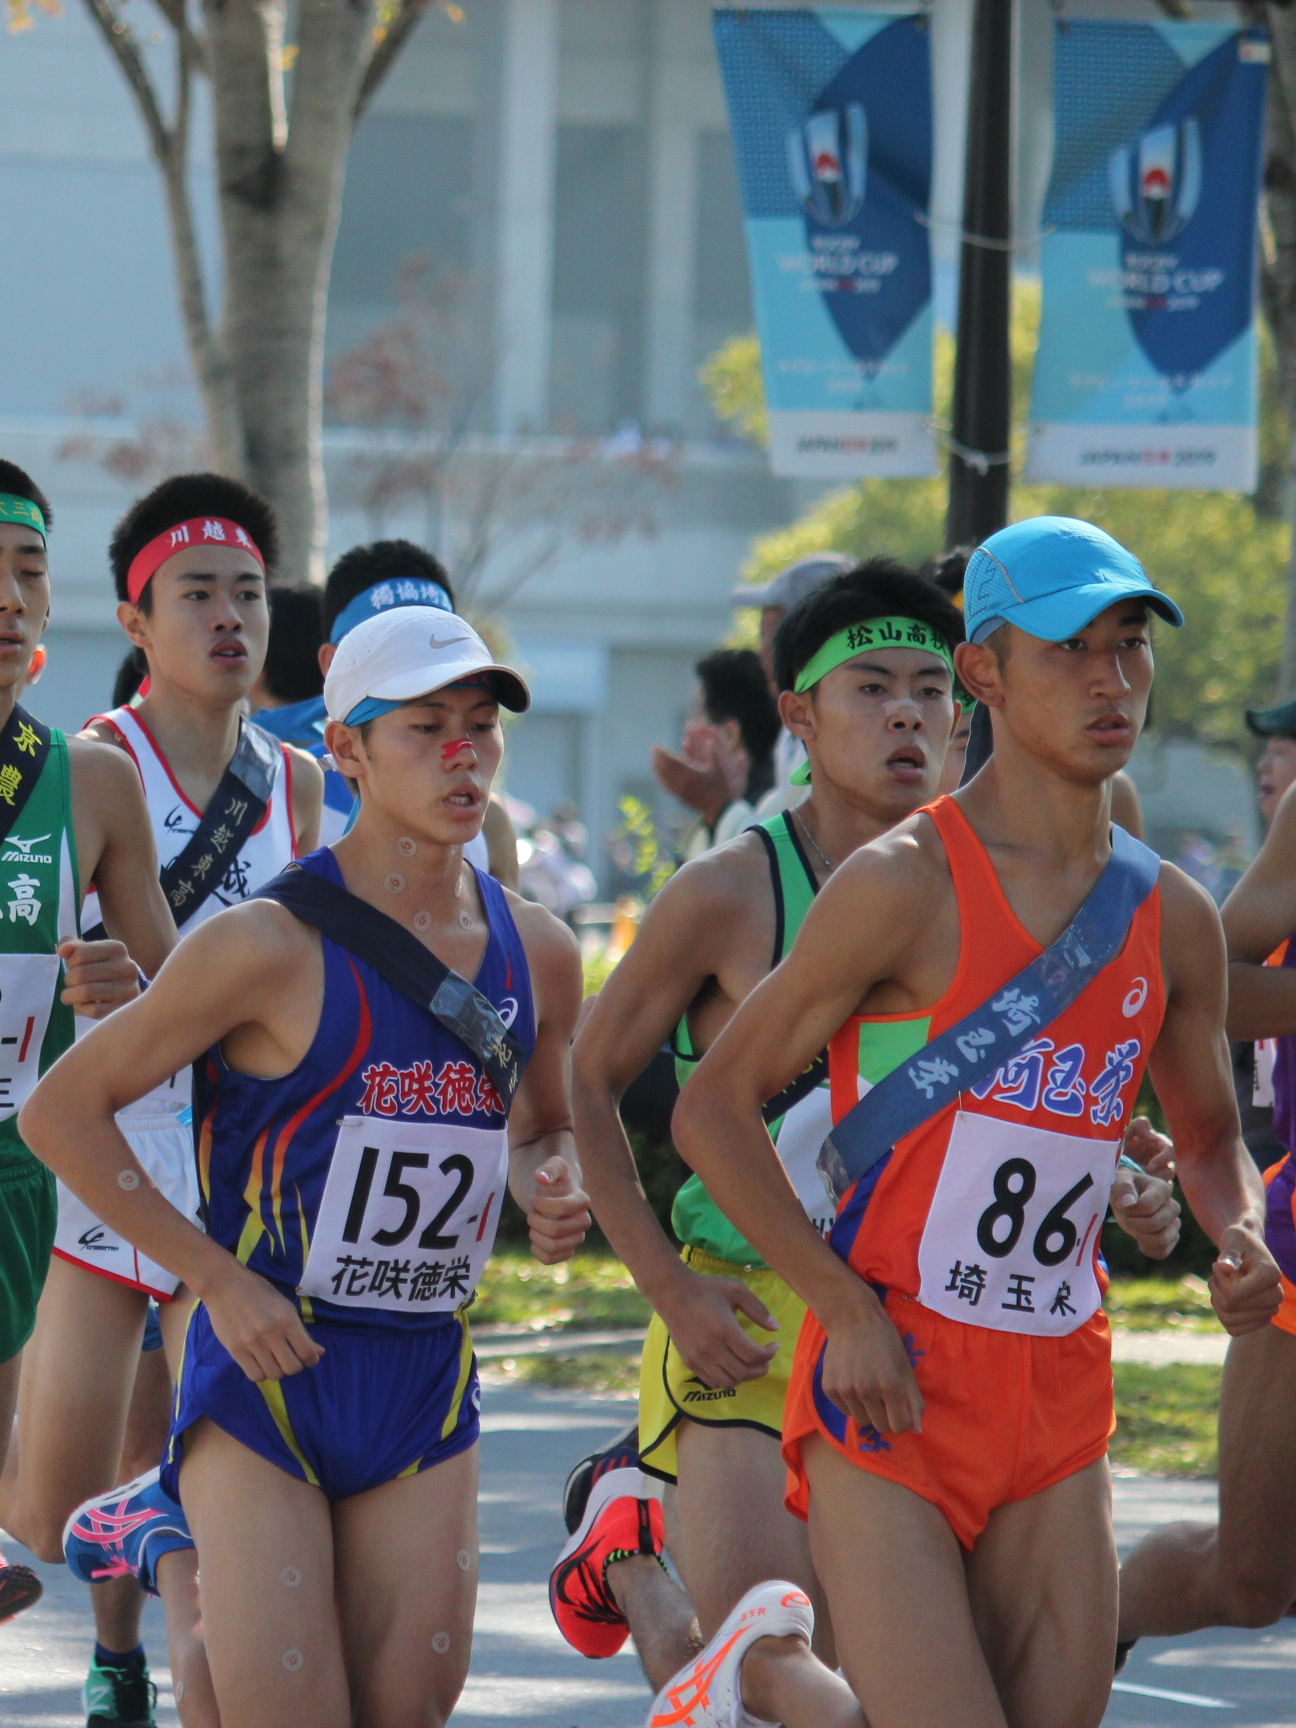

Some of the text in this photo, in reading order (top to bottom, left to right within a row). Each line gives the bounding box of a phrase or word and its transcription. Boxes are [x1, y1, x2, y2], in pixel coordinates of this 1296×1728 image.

[777, 252, 899, 276] WORLD CUP
[1087, 270, 1225, 294] WORLD CUP
[0, 850, 53, 864] MIZUNO
[356, 1060, 506, 1117] 花咲徳栄
[341, 1146, 496, 1251] 152-1
[976, 1157, 1100, 1268] 86-1
[330, 1254, 471, 1303] 花咲徳栄
[944, 1259, 1078, 1318] 埼玉栄
[682, 1389, 737, 1403] MIZUNO
